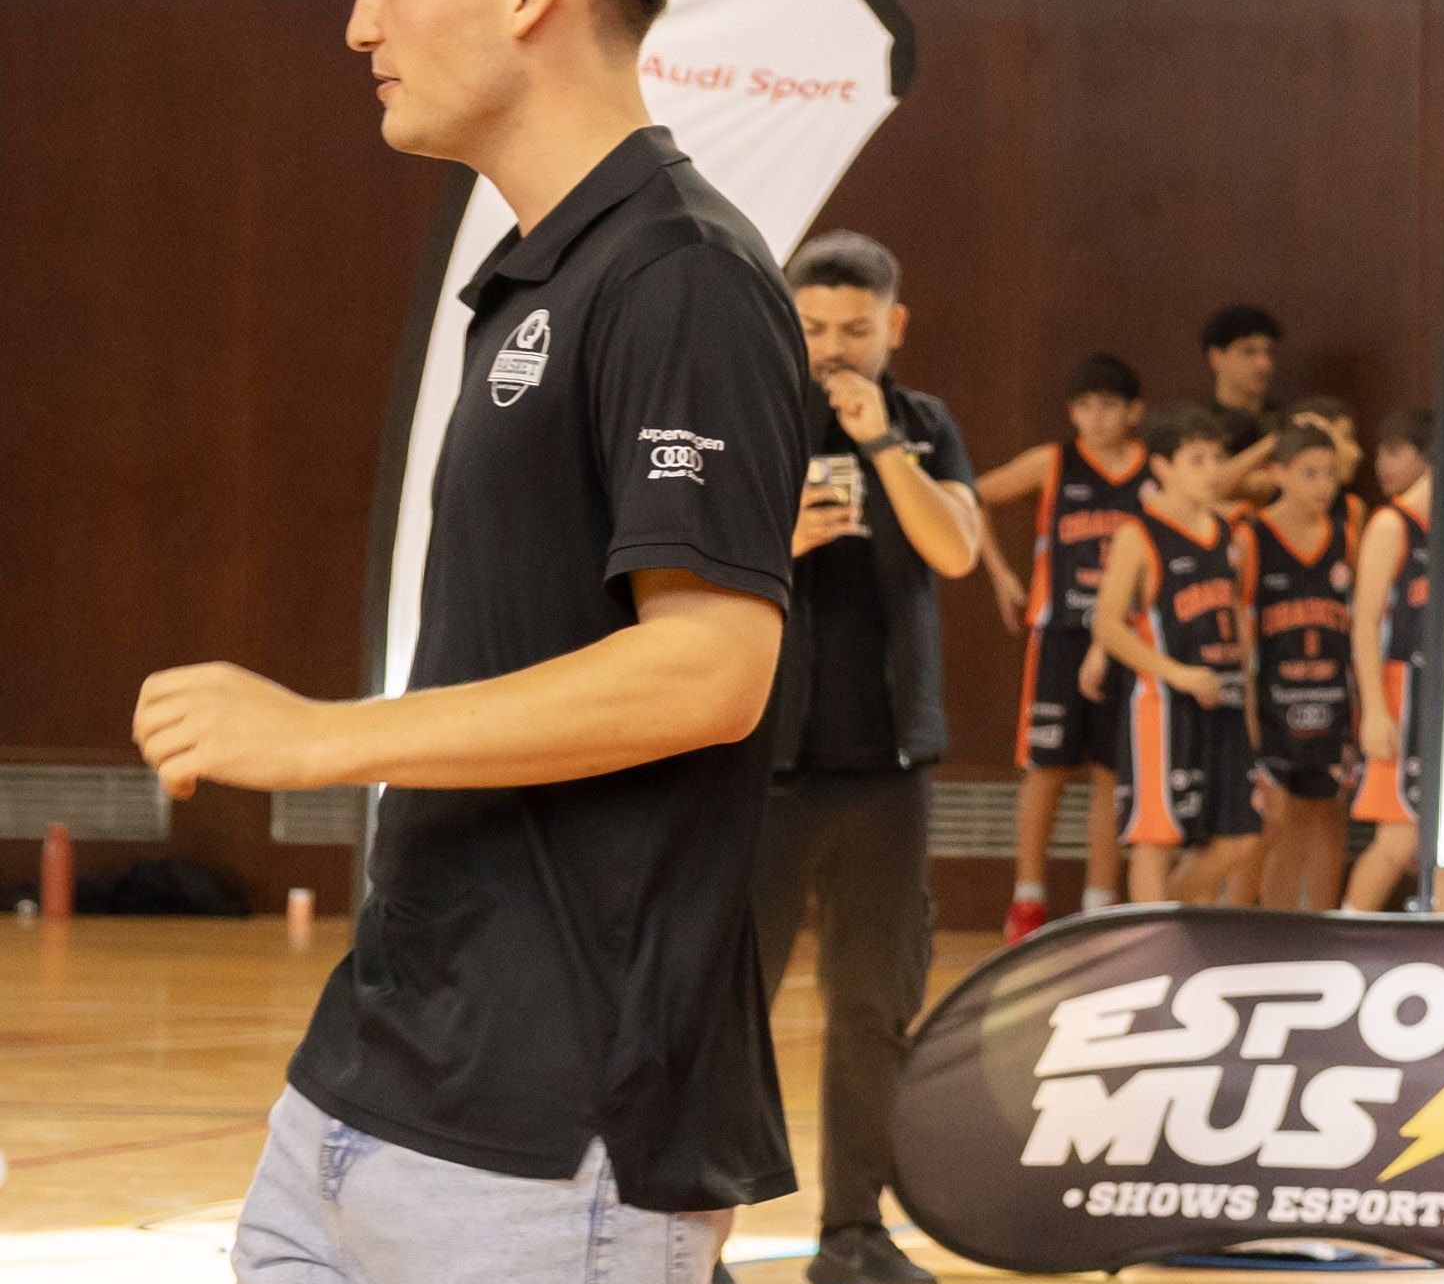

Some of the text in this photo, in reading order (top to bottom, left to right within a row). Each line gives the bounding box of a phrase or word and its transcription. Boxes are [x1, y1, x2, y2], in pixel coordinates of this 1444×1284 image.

[640, 53, 857, 103] Audi Sport
[1086, 1180, 1259, 1221] SHOWS
